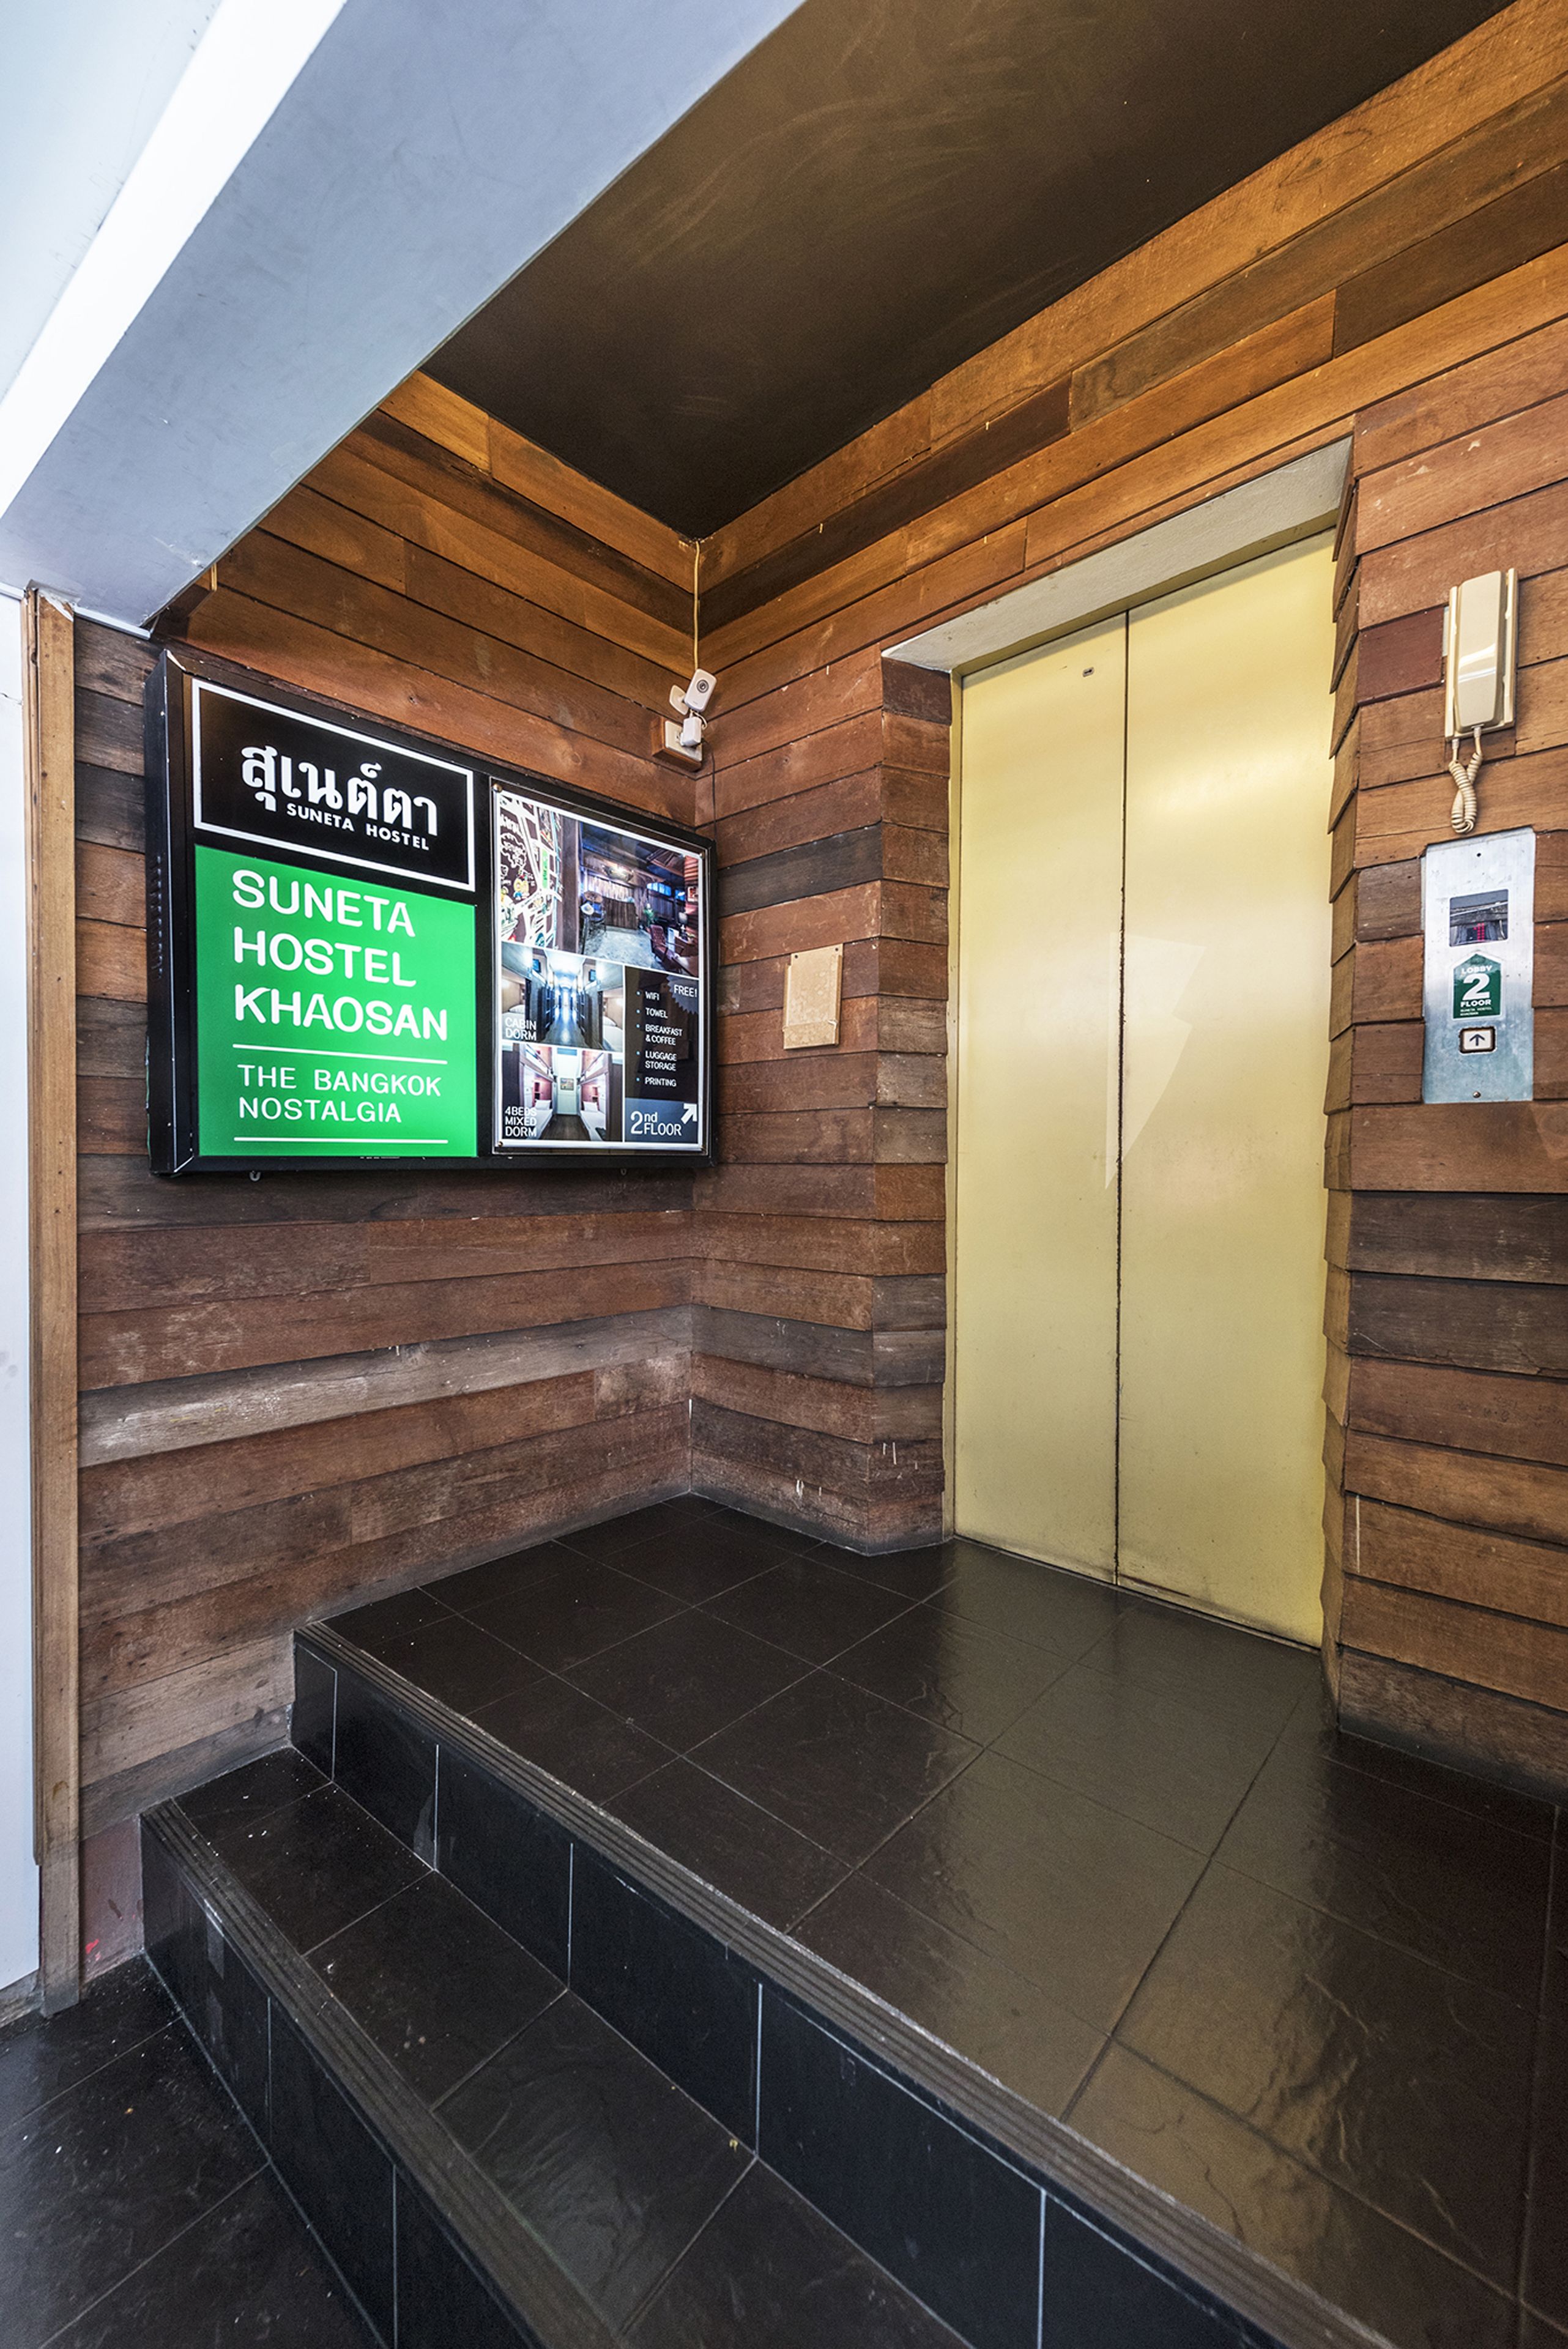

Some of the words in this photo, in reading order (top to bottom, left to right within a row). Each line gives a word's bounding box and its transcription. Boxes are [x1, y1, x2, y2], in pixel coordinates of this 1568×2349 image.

[287, 803, 354, 832] SUNETA
[366, 823, 429, 850] HOSTEL
[232, 870, 415, 937] SUNETA
[234, 926, 417, 987] HOSTEL
[1462, 965, 1493, 974] LOBBY
[674, 984, 697, 998] FREE!
[1462, 973, 1490, 1000] 2
[645, 991, 660, 1001] WIFI
[1460, 999, 1492, 1008] FLOOR
[235, 984, 447, 1041] KHAOSAN
[645, 1008, 668, 1019] TOWEL
[505, 1017, 537, 1030] CABIN
[645, 1024, 683, 1036] BREAKFAST
[506, 1028, 537, 1041] DORM
[645, 1050, 677, 1061] LUGGAGE
[645, 1061, 676, 1071] STORAGE
[237, 1064, 296, 1089] THE
[314, 1069, 441, 1097] BANGKOK
[645, 1077, 677, 1087] PRINTING
[239, 1097, 402, 1123] NOSTALGIA
[505, 1116, 537, 1126] MIXED
[630, 1110, 658, 1135] 2nd
[505, 1126, 537, 1137] DORM
[644, 1123, 682, 1136] FLOOR
